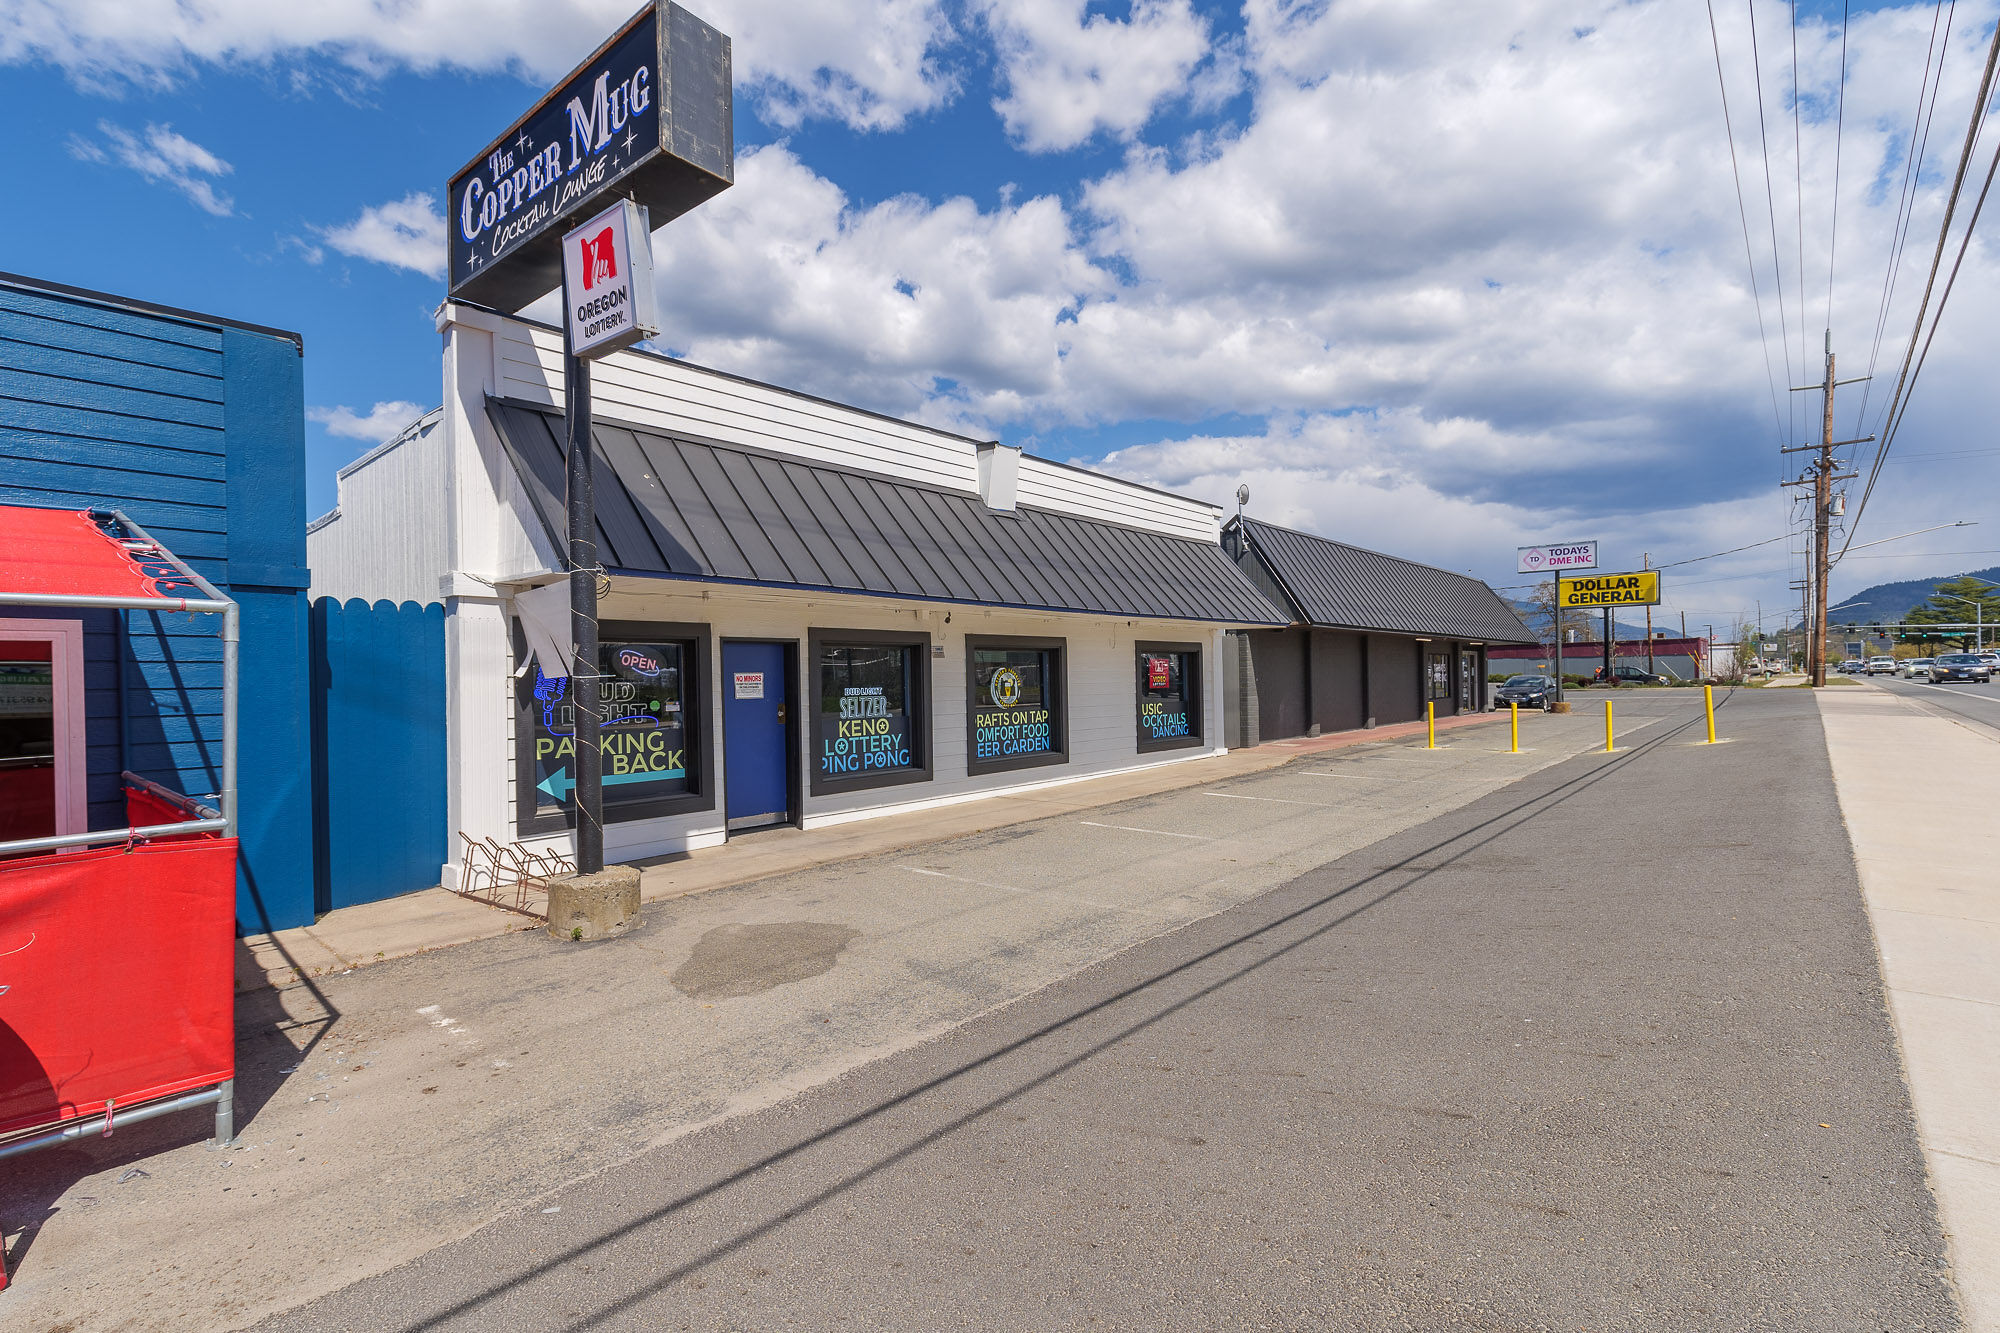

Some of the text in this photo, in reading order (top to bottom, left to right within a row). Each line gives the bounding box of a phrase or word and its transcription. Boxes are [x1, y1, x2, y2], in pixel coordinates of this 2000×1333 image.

[459, 65, 650, 243] COPPER MUG
[492, 154, 608, 257] COCKTAIL LOUNGE
[577, 285, 628, 323] OREGON
[584, 311, 625, 338] LOTTERY
[1549, 545, 1589, 556] TODAYS
[1549, 554, 1592, 565] DME INC
[1573, 577, 1640, 592] DOLLAR
[1568, 589, 1645, 604] GENERAL
[621, 654, 657, 671] OPEN
[736, 675, 762, 683] NO MINORS
[599, 682, 636, 703] UD
[844, 687, 882, 696] BUD LIGHT
[839, 696, 887, 719] SELTZER
[1142, 702, 1163, 716] USIC
[838, 718, 889, 738] KENO
[976, 710, 1048, 728] RAFTS ON TAP
[1142, 712, 1186, 728] OCKTAILS
[976, 722, 1049, 742] OMFORT FOOD
[1152, 724, 1189, 738] DANCING
[536, 731, 665, 760] PAKING
[824, 733, 902, 757] LOTTERY
[977, 736, 1050, 758] EER GARDEN
[613, 749, 684, 775] BACK
[864, 748, 909, 770] PONG
